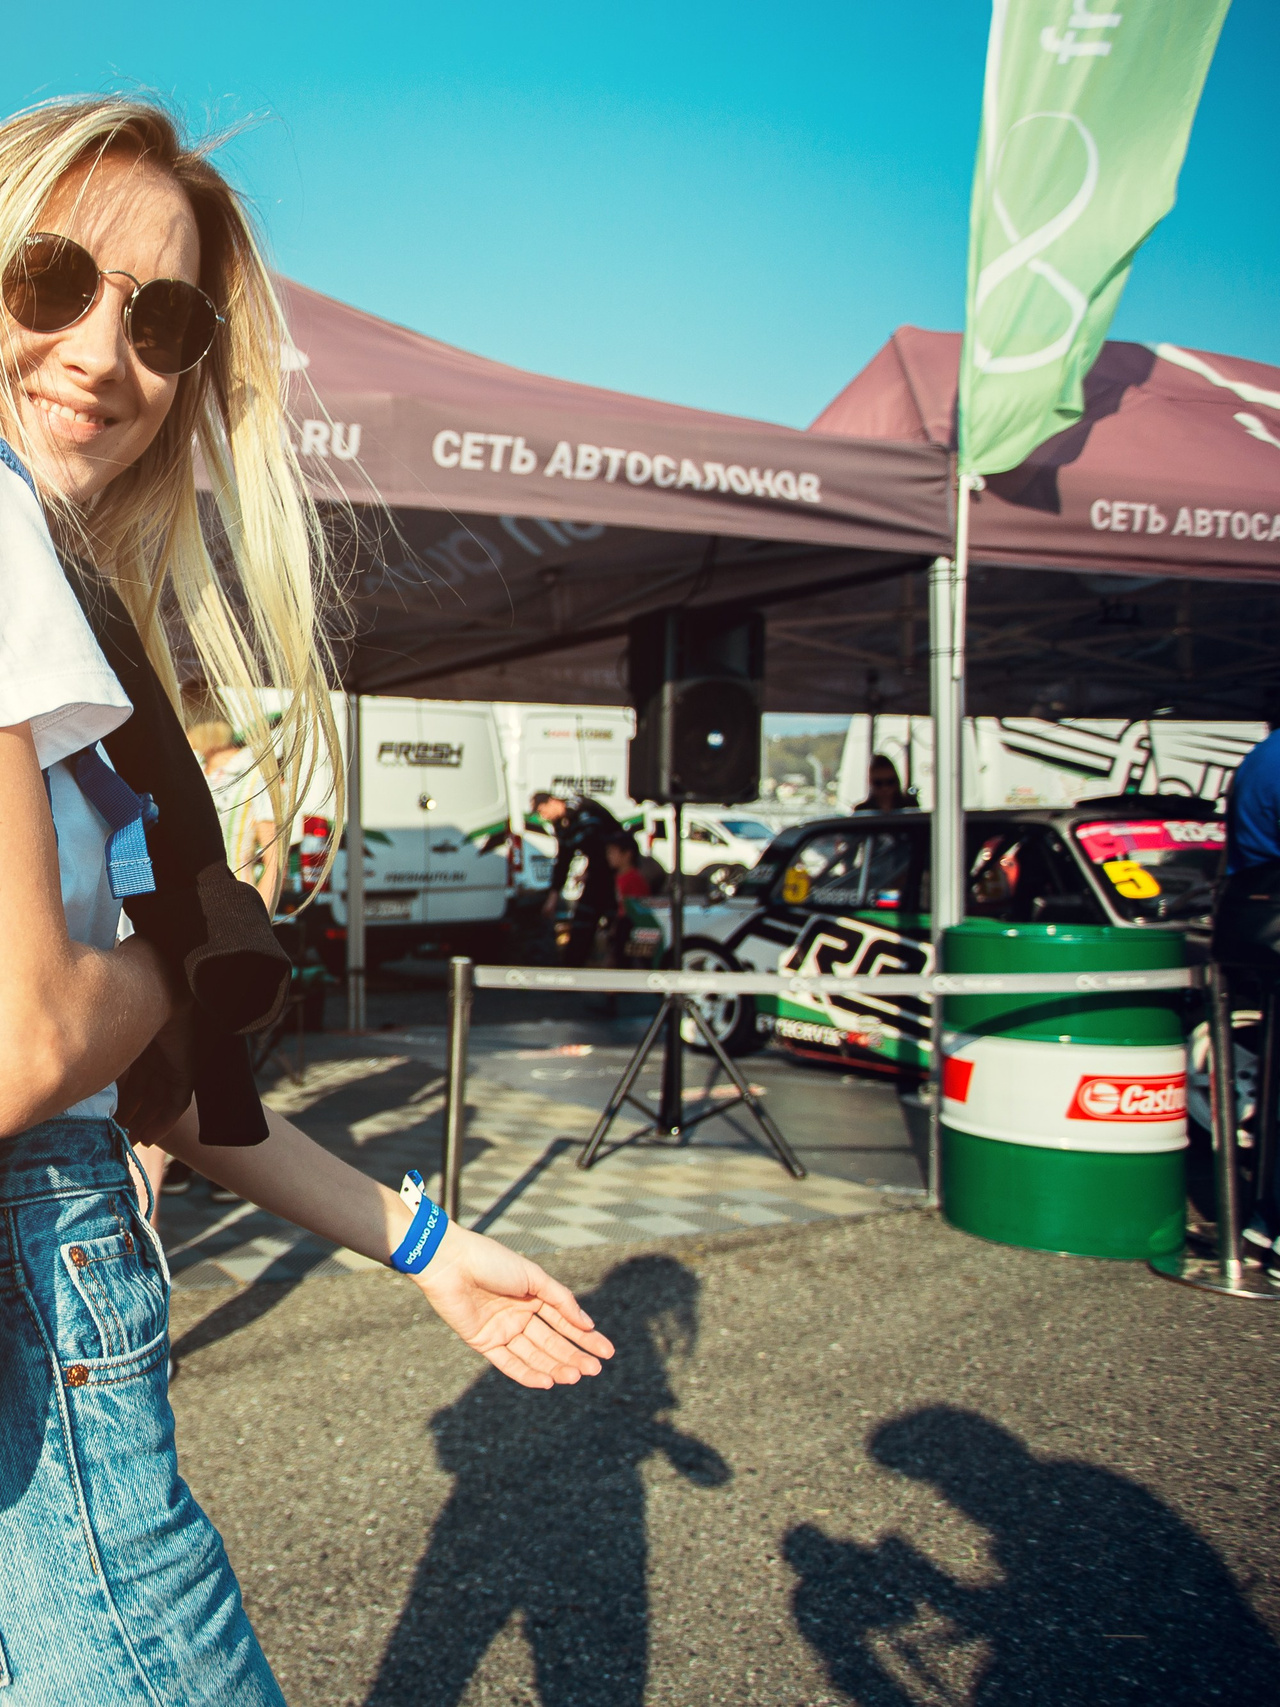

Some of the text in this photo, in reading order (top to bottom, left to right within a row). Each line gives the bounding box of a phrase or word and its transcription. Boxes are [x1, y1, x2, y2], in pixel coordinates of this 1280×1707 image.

[432, 428, 821, 503] СЕТЬ АВТОСАЛОНОВ
[1090, 499, 1167, 535] СЕТЬ
[1103, 860, 1161, 899] 5
